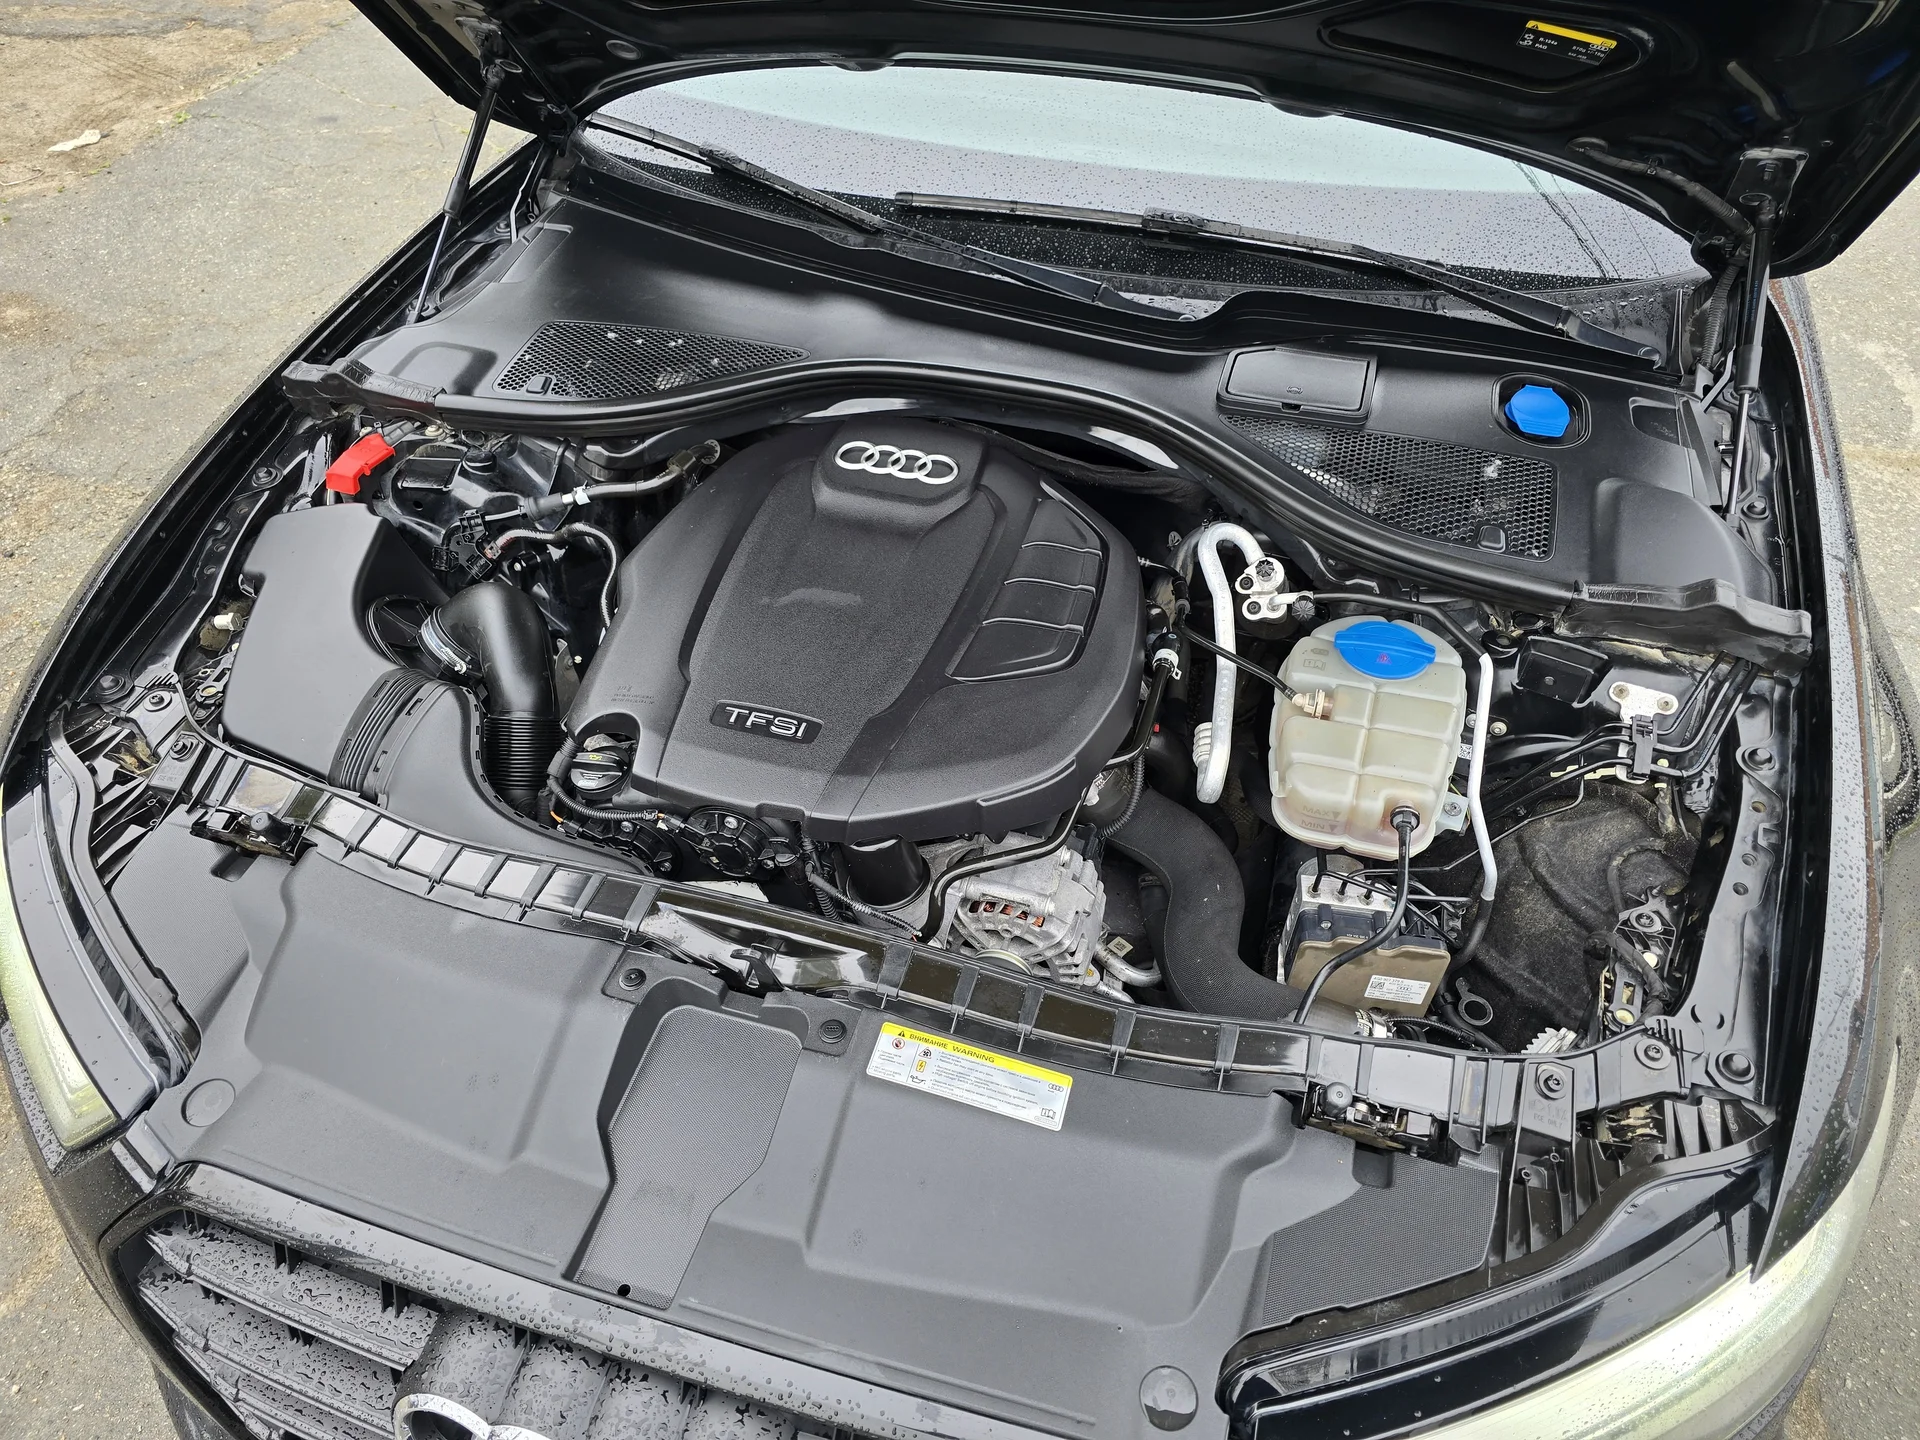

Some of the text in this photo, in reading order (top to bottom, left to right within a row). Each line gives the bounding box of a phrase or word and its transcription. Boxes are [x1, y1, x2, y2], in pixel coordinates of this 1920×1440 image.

[725, 706, 808, 739] TFSI
[1302, 805, 1330, 817] MAX
[1301, 819, 1325, 830] MIN
[910, 1034, 948, 1050] ВНИМАНИЕ
[952, 1046, 995, 1063] WARNING
